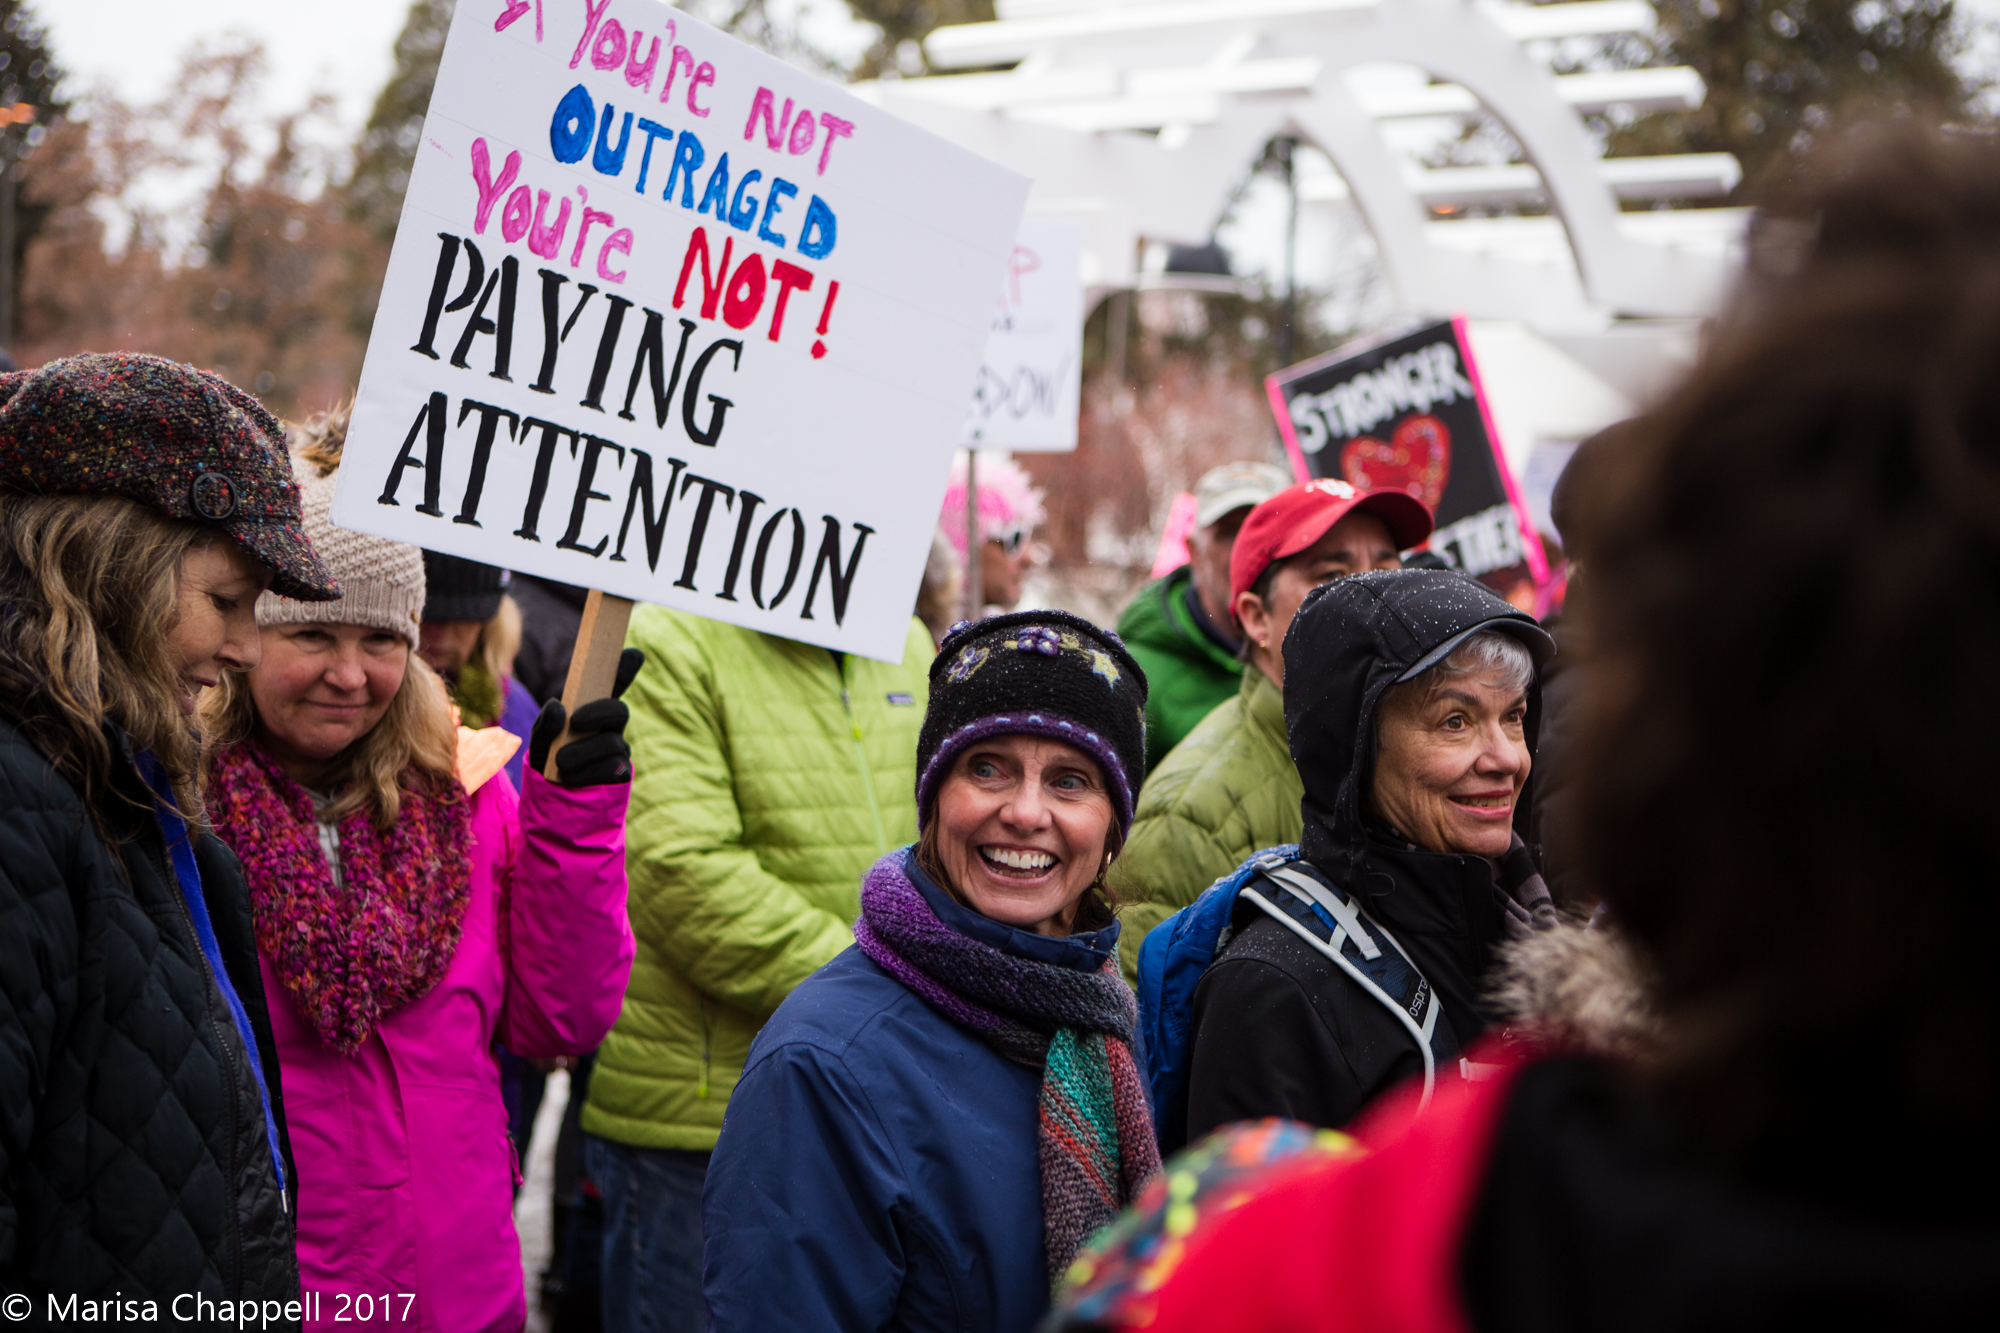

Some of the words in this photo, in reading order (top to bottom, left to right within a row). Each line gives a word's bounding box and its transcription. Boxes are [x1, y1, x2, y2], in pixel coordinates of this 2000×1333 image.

[549, 83, 838, 261] OUTRAGED
[569, 0, 716, 118] You're
[744, 86, 856, 176] NOT
[410, 231, 744, 447] PAYING
[470, 137, 634, 283] You're
[672, 226, 840, 359] NOT!
[377, 391, 877, 628] ATTENTION
